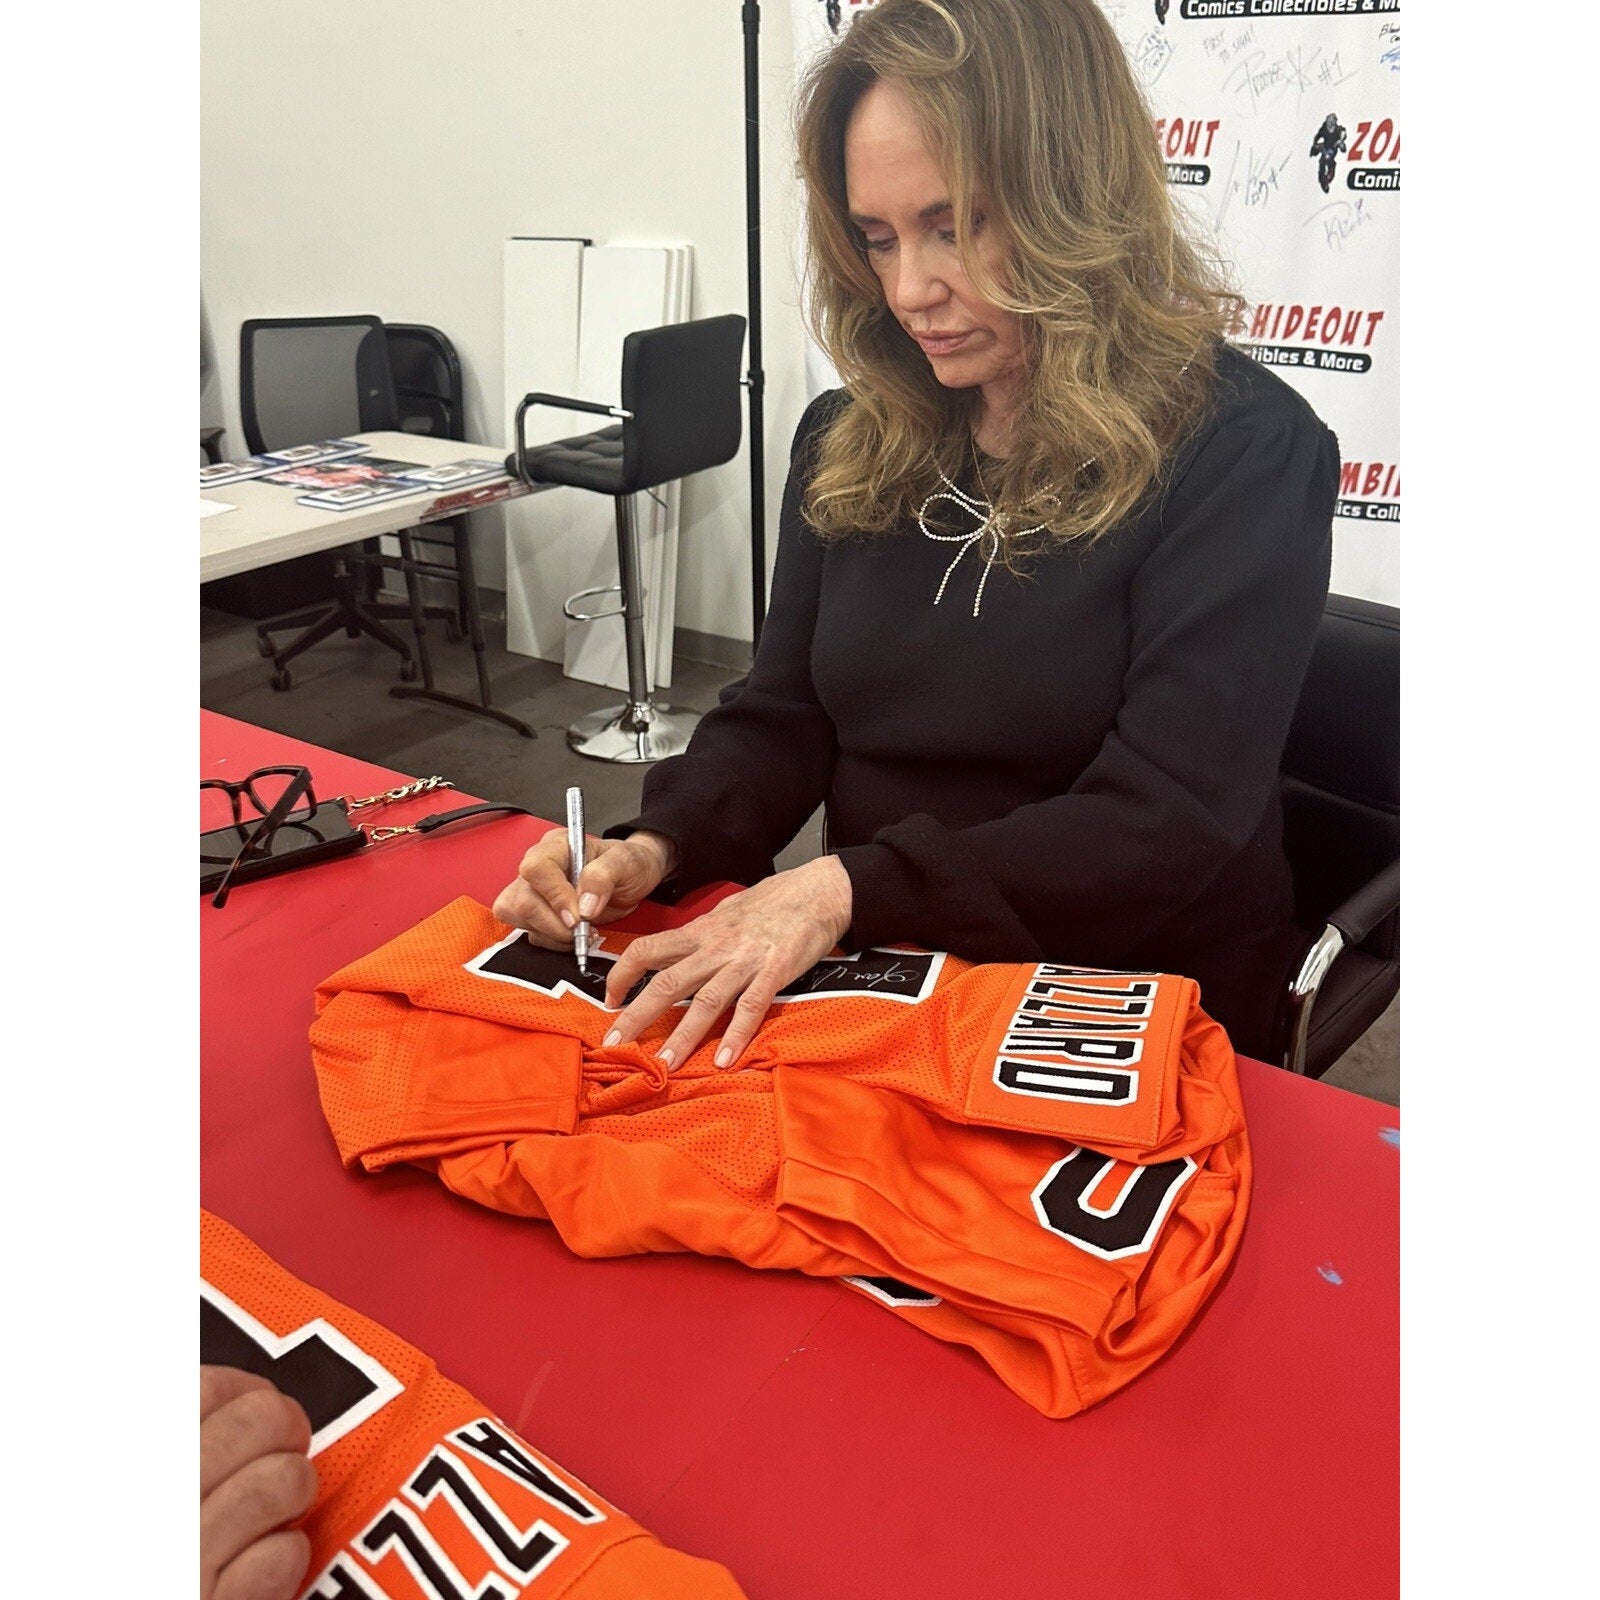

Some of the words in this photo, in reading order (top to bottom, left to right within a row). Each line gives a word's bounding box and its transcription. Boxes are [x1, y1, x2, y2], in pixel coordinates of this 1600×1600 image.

[1186, 0, 1245, 16] Comics
[1346, 118, 1400, 163] ZO
[1353, 170, 1400, 188] Comi
[1251, 303, 1385, 347] HIDEOUT
[1303, 350, 1317, 367] &
[1320, 353, 1364, 372] More
[1341, 462, 1400, 497] MBI
[1366, 504, 1400, 520] Coll
